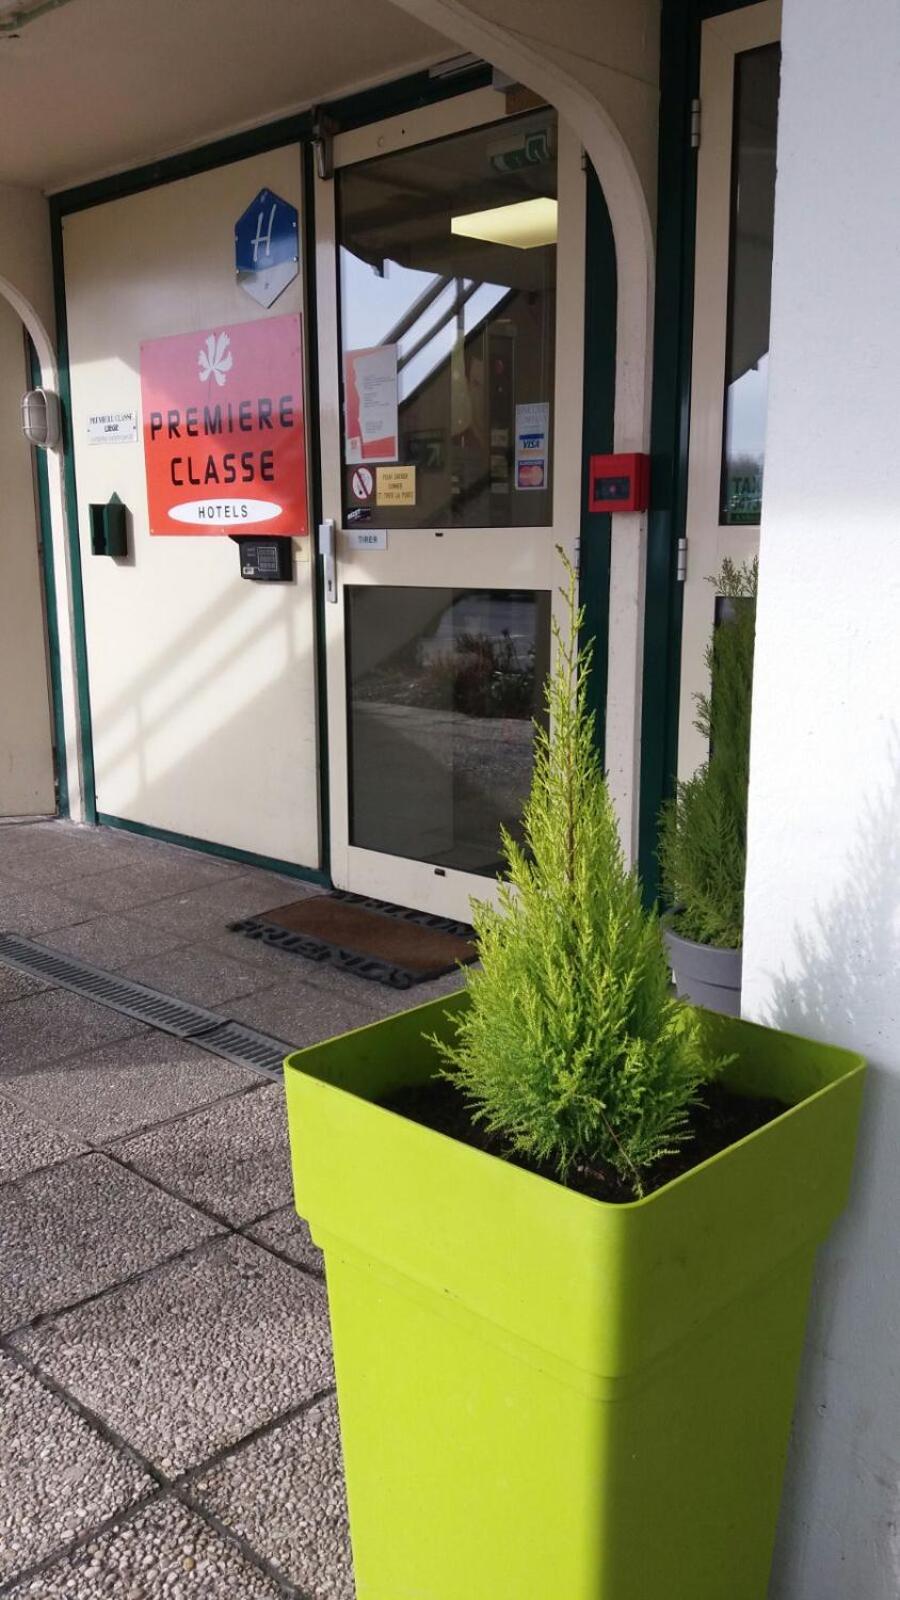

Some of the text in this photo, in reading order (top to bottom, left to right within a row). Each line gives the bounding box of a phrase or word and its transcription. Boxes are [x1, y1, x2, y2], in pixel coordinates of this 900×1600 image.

[250, 203, 277, 262] H
[150, 395, 294, 441] PREMIERE
[522, 439, 540, 449] VISA
[170, 450, 275, 486] CLASSE
[198, 505, 248, 519] HOTELS
[358, 535, 378, 544] TIRER
